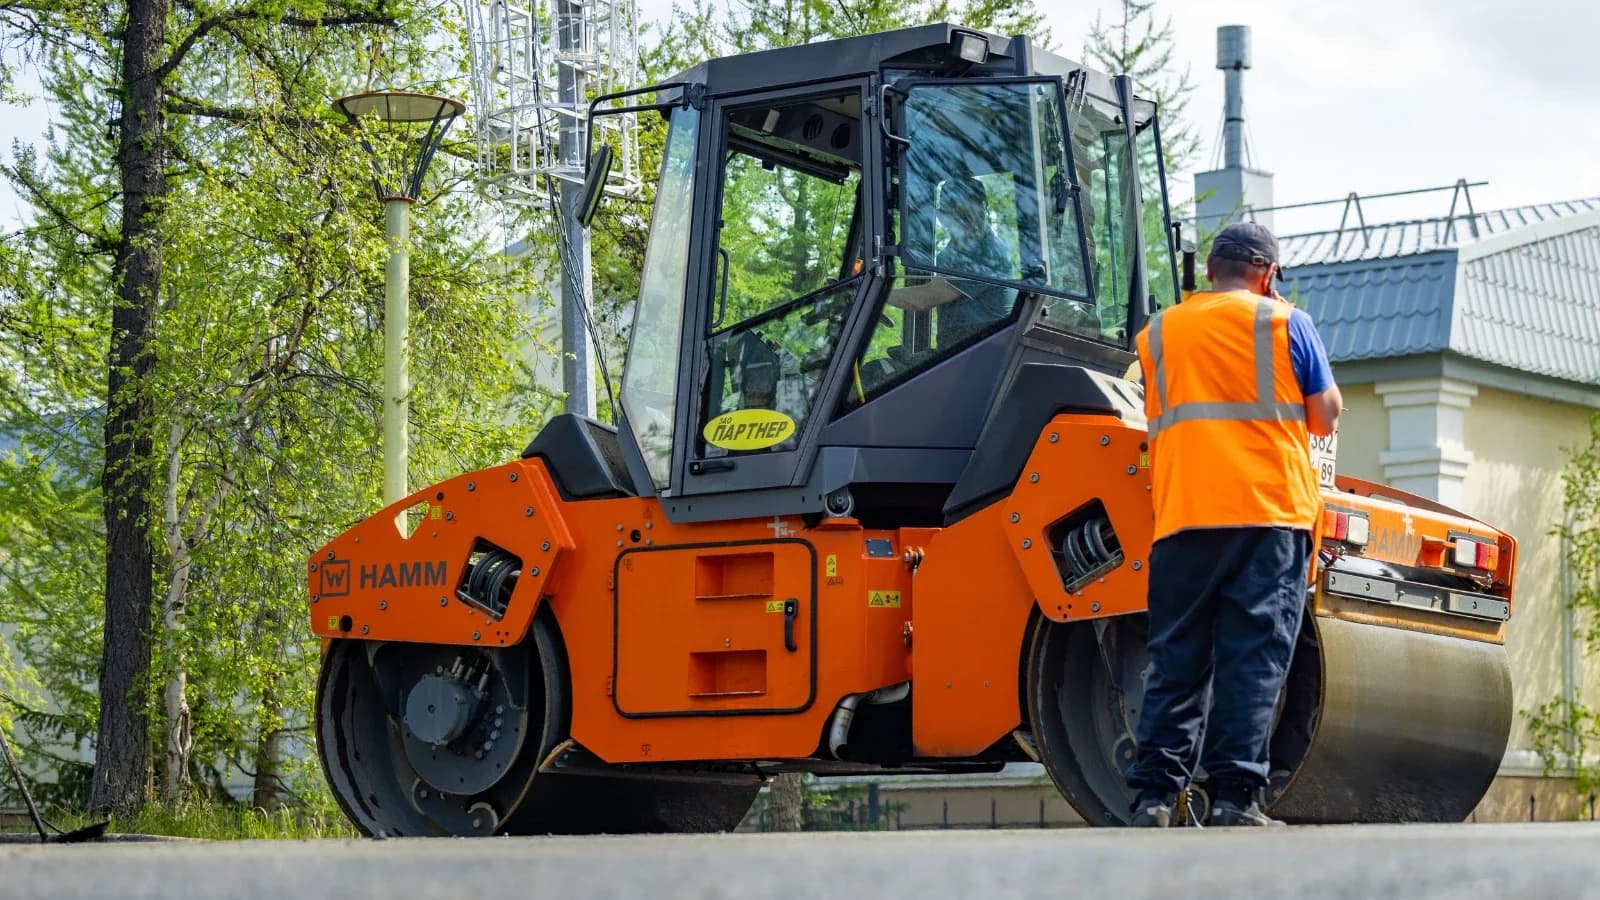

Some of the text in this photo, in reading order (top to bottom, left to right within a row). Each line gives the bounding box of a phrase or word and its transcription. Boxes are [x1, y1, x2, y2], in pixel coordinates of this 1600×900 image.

[712, 421, 789, 441] ПАРТНЕР
[1321, 462, 1333, 482] 89
[359, 560, 447, 589] HAMM
